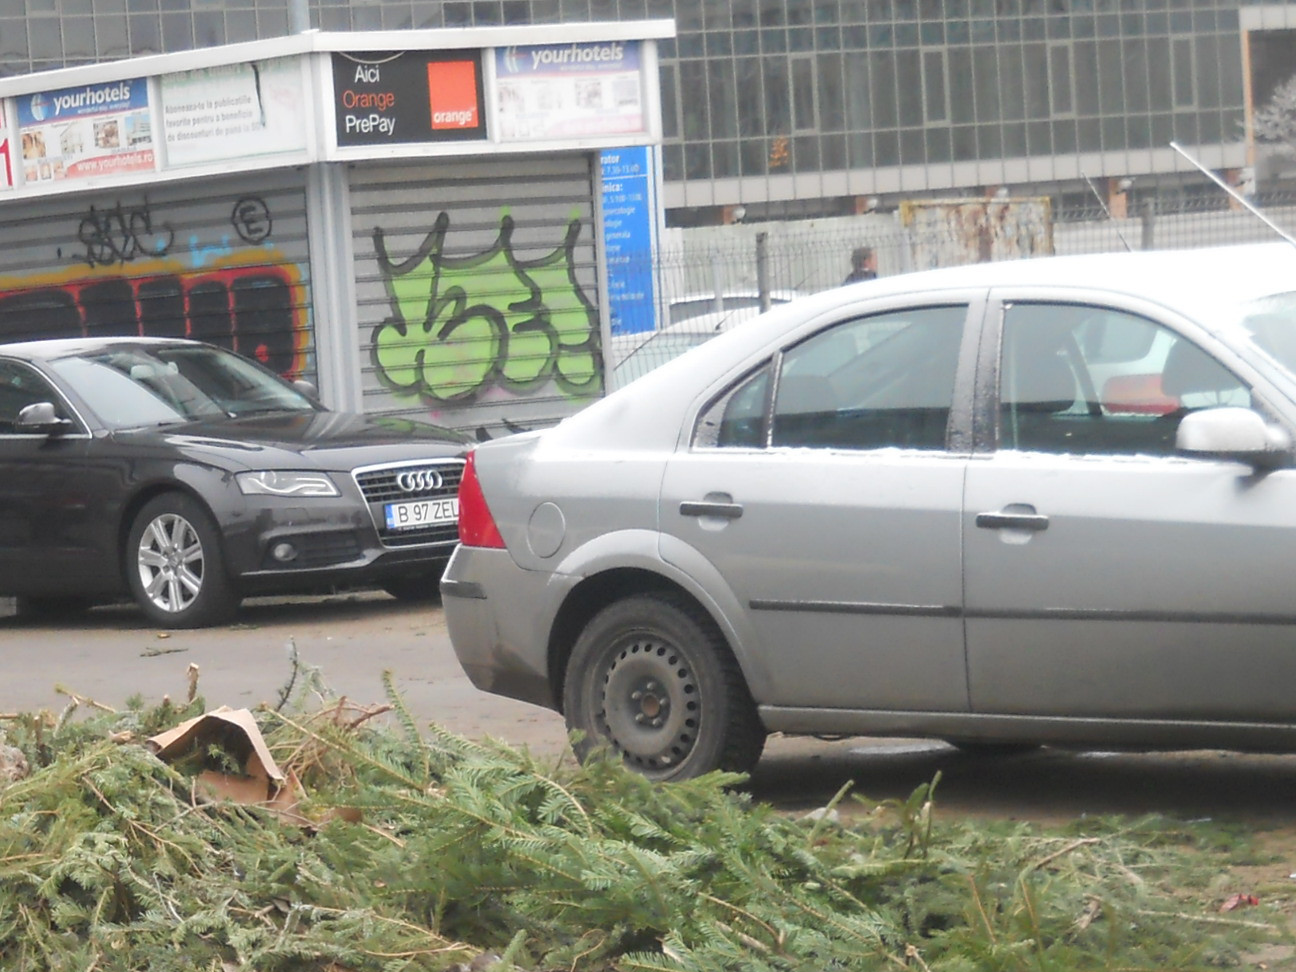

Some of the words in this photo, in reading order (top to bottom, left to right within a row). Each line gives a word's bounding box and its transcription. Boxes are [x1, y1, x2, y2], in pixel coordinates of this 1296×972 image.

[532, 42, 624, 70] yourhotels
[354, 65, 380, 83] Aici
[53, 82, 131, 116] yourhotels
[342, 90, 395, 111] Orange
[345, 114, 396, 136] PrePay
[433, 110, 473, 126] orange
[398, 505, 409, 523] B
[413, 503, 429, 521] 97
